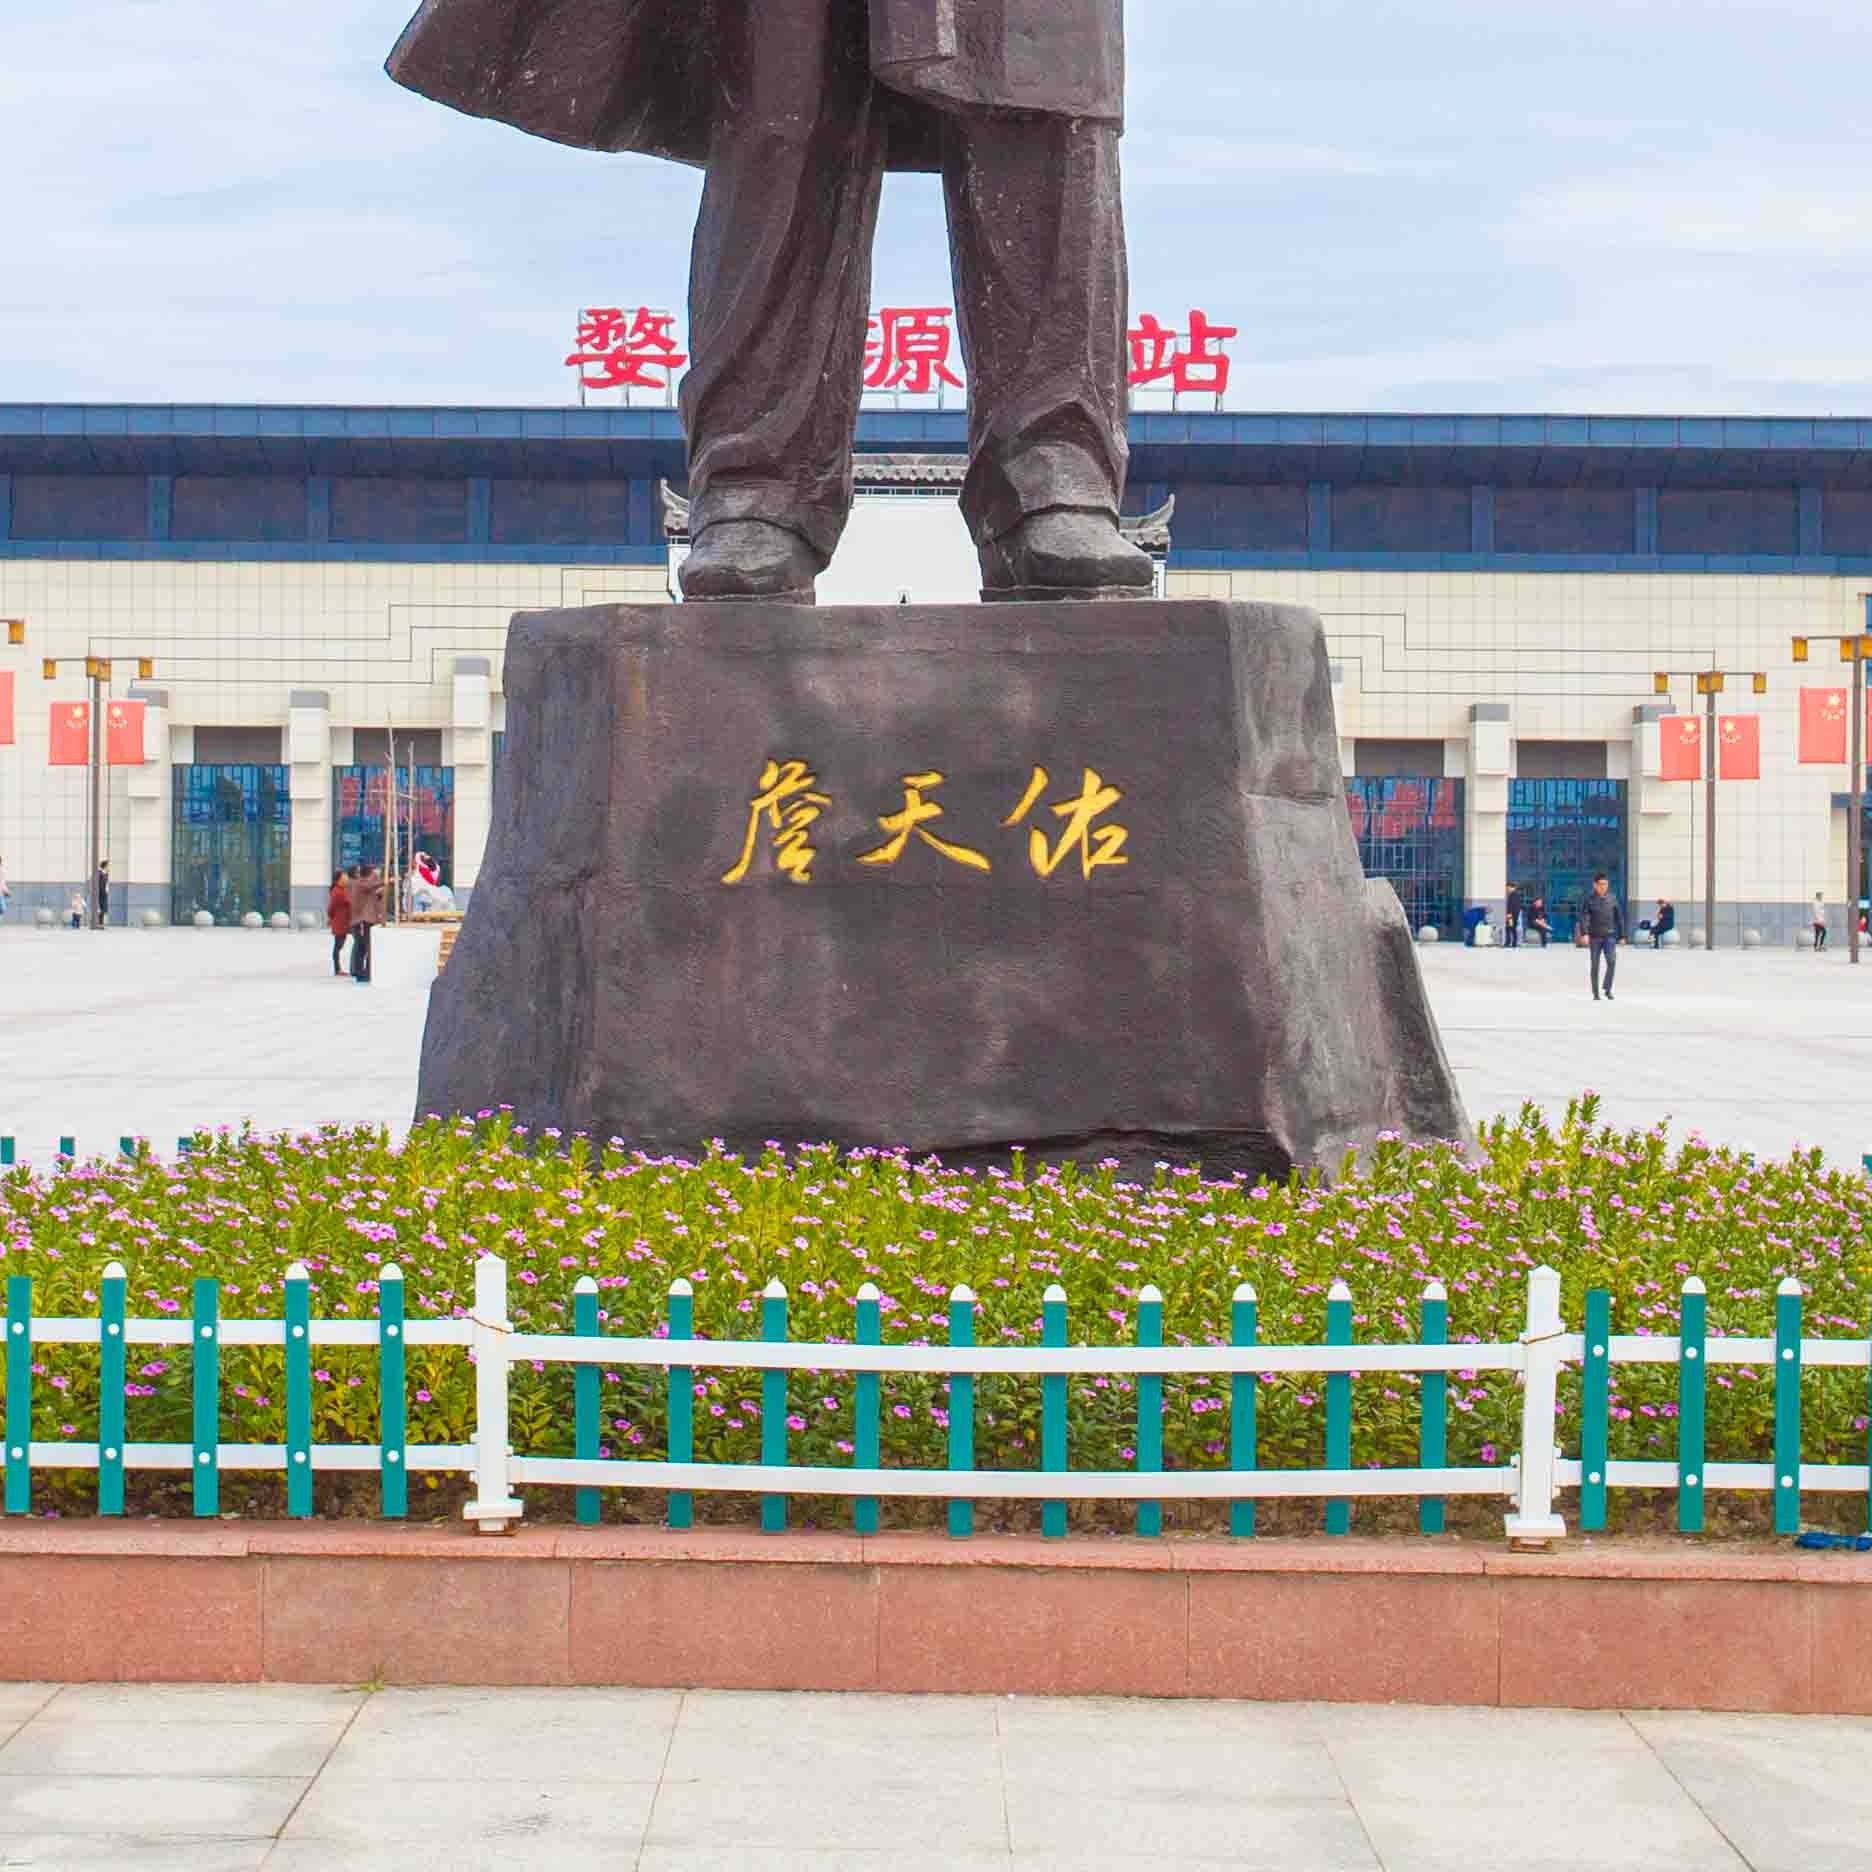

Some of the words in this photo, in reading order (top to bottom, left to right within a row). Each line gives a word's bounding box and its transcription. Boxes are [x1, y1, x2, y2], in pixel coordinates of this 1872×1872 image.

[565, 306, 1238, 393] 婺源站
[721, 760, 1128, 883] 詹天佑
